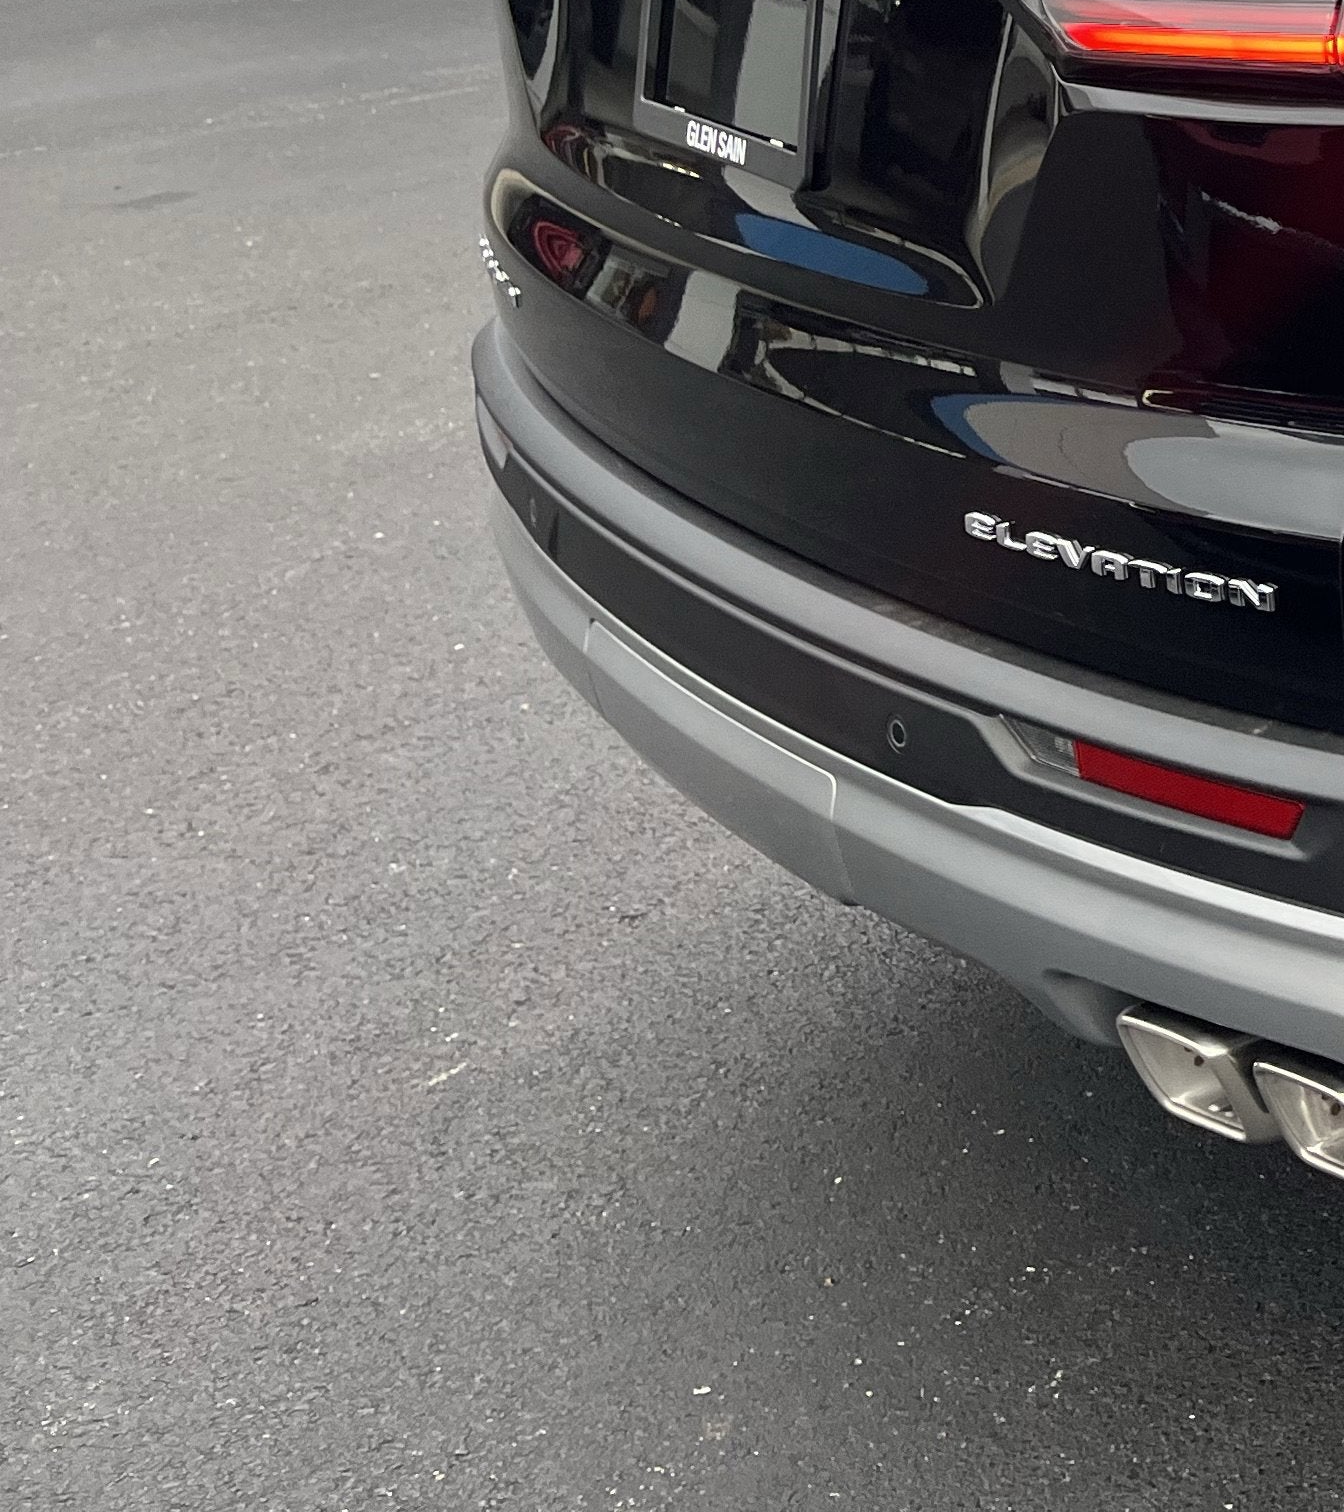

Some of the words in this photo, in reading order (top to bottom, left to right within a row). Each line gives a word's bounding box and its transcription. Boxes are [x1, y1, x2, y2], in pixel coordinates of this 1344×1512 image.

[686, 120, 718, 155] GLEN
[717, 131, 747, 165] SAIN
[964, 510, 1278, 613] ELEVATION
